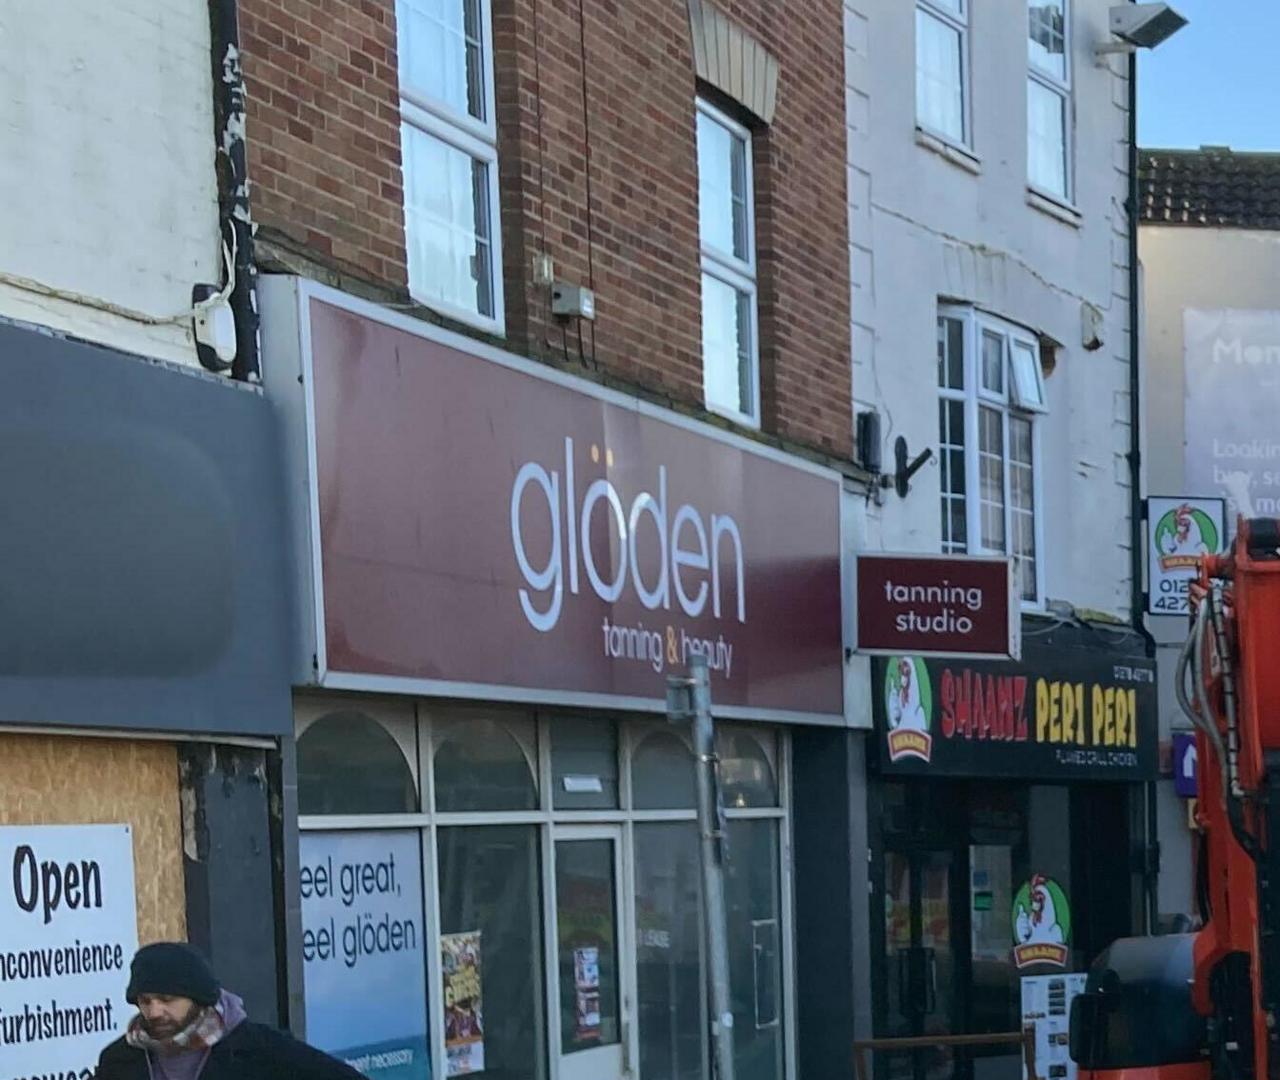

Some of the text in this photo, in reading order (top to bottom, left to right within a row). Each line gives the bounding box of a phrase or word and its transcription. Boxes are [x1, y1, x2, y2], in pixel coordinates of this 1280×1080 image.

[511, 436, 746, 632] glöden
[885, 580, 983, 610] tanning
[1160, 579, 1190, 593] 012
[603, 617, 733, 679] tanning & beauty
[896, 609, 973, 633] studio
[1035, 677, 1085, 746] PERI
[1092, 682, 1137, 748] PERI
[13, 844, 103, 925] Open
[340, 853, 402, 906] great,
[344, 913, 417, 968] glöden
